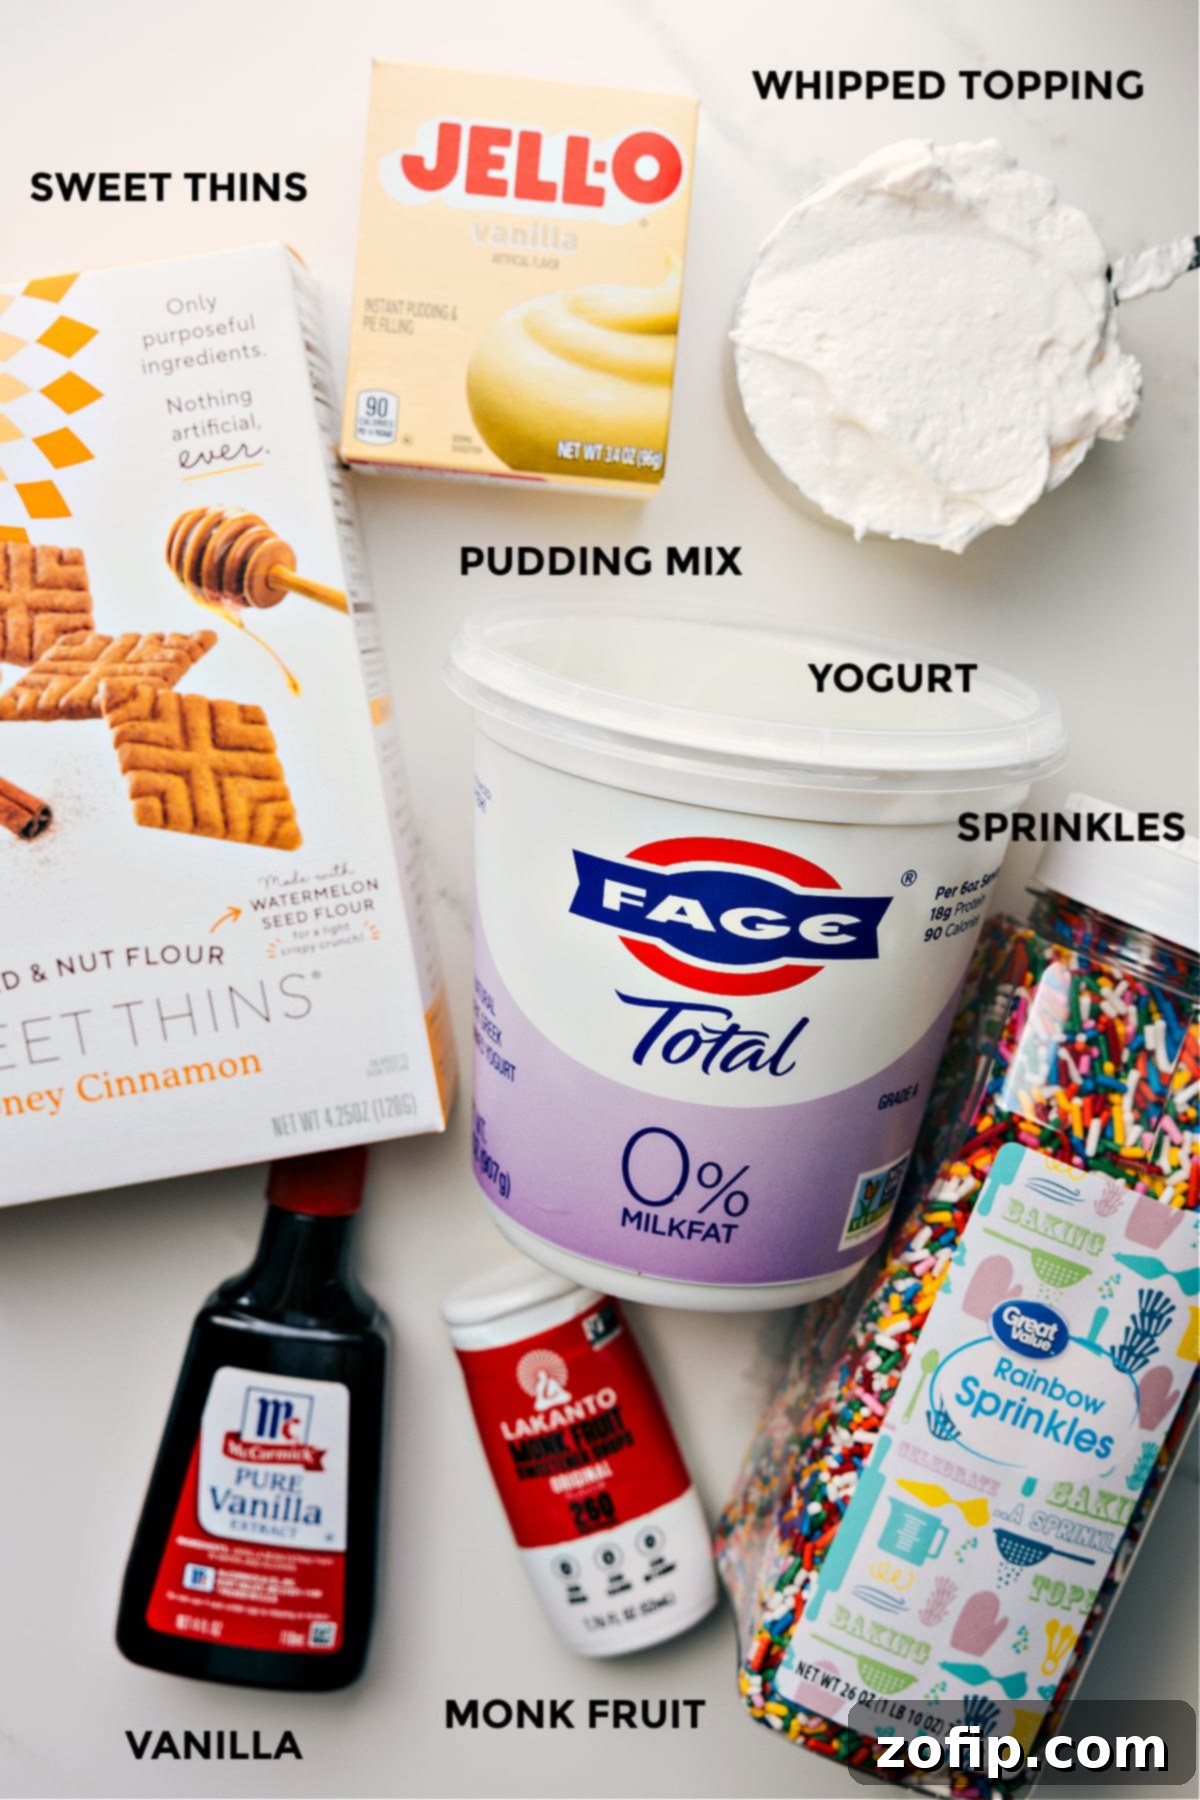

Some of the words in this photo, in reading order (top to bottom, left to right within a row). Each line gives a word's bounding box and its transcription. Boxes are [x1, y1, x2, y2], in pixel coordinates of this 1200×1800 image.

[471, 222, 578, 255] vanilla
[166, 294, 217, 315] Only
[364, 298, 404, 315] INSTANT
[406, 302, 449, 320] PUDDING
[142, 314, 256, 350] purposeful
[363, 315, 377, 332] PIE
[379, 318, 415, 335] FILLING
[141, 343, 266, 376] ingredients.
[166, 389, 253, 415] Nothing
[366, 396, 388, 418] 90
[171, 413, 261, 442] artificial,
[178, 443, 270, 469] ever.
[557, 440, 581, 459] NET
[583, 442, 603, 461] WT
[250, 878, 380, 912] WATERMELON
[935, 886, 958, 900] Per
[262, 909, 308, 930] SEED
[314, 898, 375, 921] FLOUR
[602, 878, 862, 945] FAGE
[930, 906, 953, 922] 18g
[292, 929, 312, 940] for
[924, 926, 943, 943] 90
[0, 970, 20, 992] D
[30, 963, 47, 983] &
[56, 949, 115, 977] NUT
[126, 944, 225, 967] FLOUR
[113, 973, 312, 1047] THINS
[614, 988, 810, 1077] Total
[1, 1087, 64, 1117] ney
[76, 1053, 262, 1103] Cinnamon
[271, 1112, 297, 1138] NET
[299, 1109, 320, 1133] WT
[373, 1091, 418, 1123] (120G)
[621, 1126, 751, 1218] 0%
[621, 1207, 739, 1244] MILKFAT
[1002, 1197, 1107, 1257] BAKING
[1002, 1305, 1059, 1342] Great
[1011, 1326, 1053, 1352] Value
[993, 1356, 1106, 1415] Rainbow
[501, 1387, 617, 1441] LAKANTO
[954, 1375, 1115, 1459] Sprinkles
[508, 1430, 570, 1463] MONK
[571, 1405, 625, 1449] FRUIT
[235, 1466, 304, 1494] PURE
[549, 1460, 613, 1494] ORIGINAL
[210, 1486, 323, 1526] Vanilla
[569, 1491, 617, 1529] 260
[230, 1518, 298, 1539] EXTRACT
[828, 1605, 933, 1665] BAKING
[795, 1660, 819, 1682] NET
[820, 1672, 841, 1693] WT
[840, 1682, 857, 1701] 26
[858, 1690, 876, 1709] OZ
[889, 1702, 906, 1720] LB
[907, 1709, 922, 1726] 10
